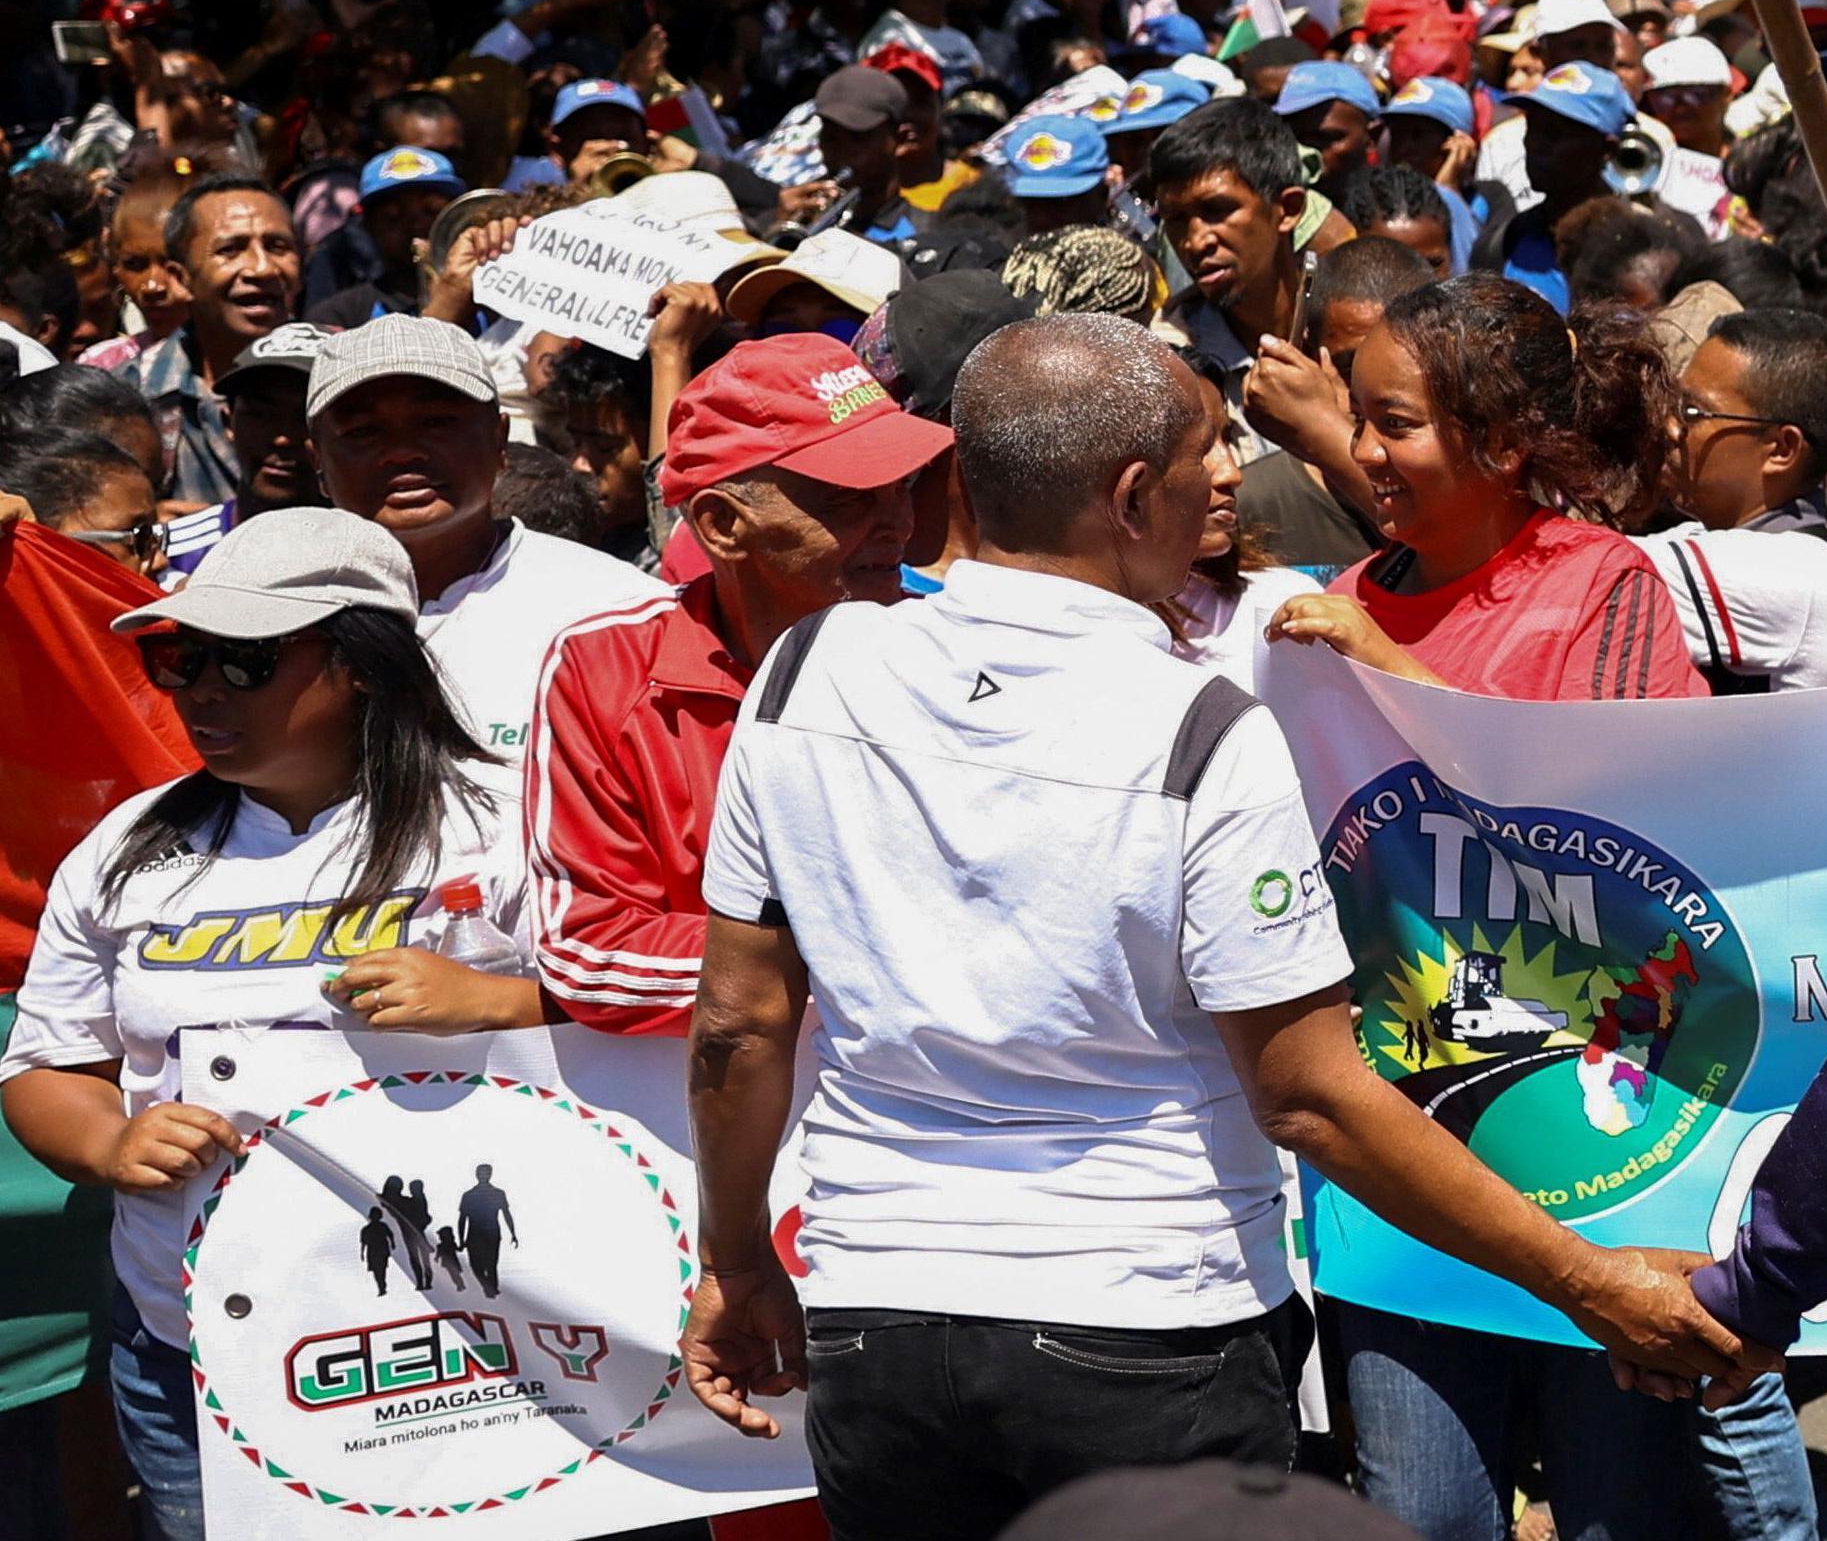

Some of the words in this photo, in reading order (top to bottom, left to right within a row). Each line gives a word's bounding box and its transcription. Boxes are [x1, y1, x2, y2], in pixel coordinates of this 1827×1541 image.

[528, 224, 628, 277] VAHOAKA
[489, 722, 529, 746] Tel
[1325, 789, 1404, 874] TIAKO
[1432, 777, 1728, 951] DAGASIKARA
[1418, 811, 1602, 949] TIM
[138, 886, 430, 972] JMU
[1573, 1061, 1728, 1200] Madagasikara
[283, 1310, 520, 1413] GEN
[528, 1322, 610, 1382] Y
[375, 1381, 546, 1422] MADAGASCAR
[344, 1436, 387, 1454] Miara
[391, 1422, 457, 1445] mitolona
[460, 1418, 479, 1431] ho
